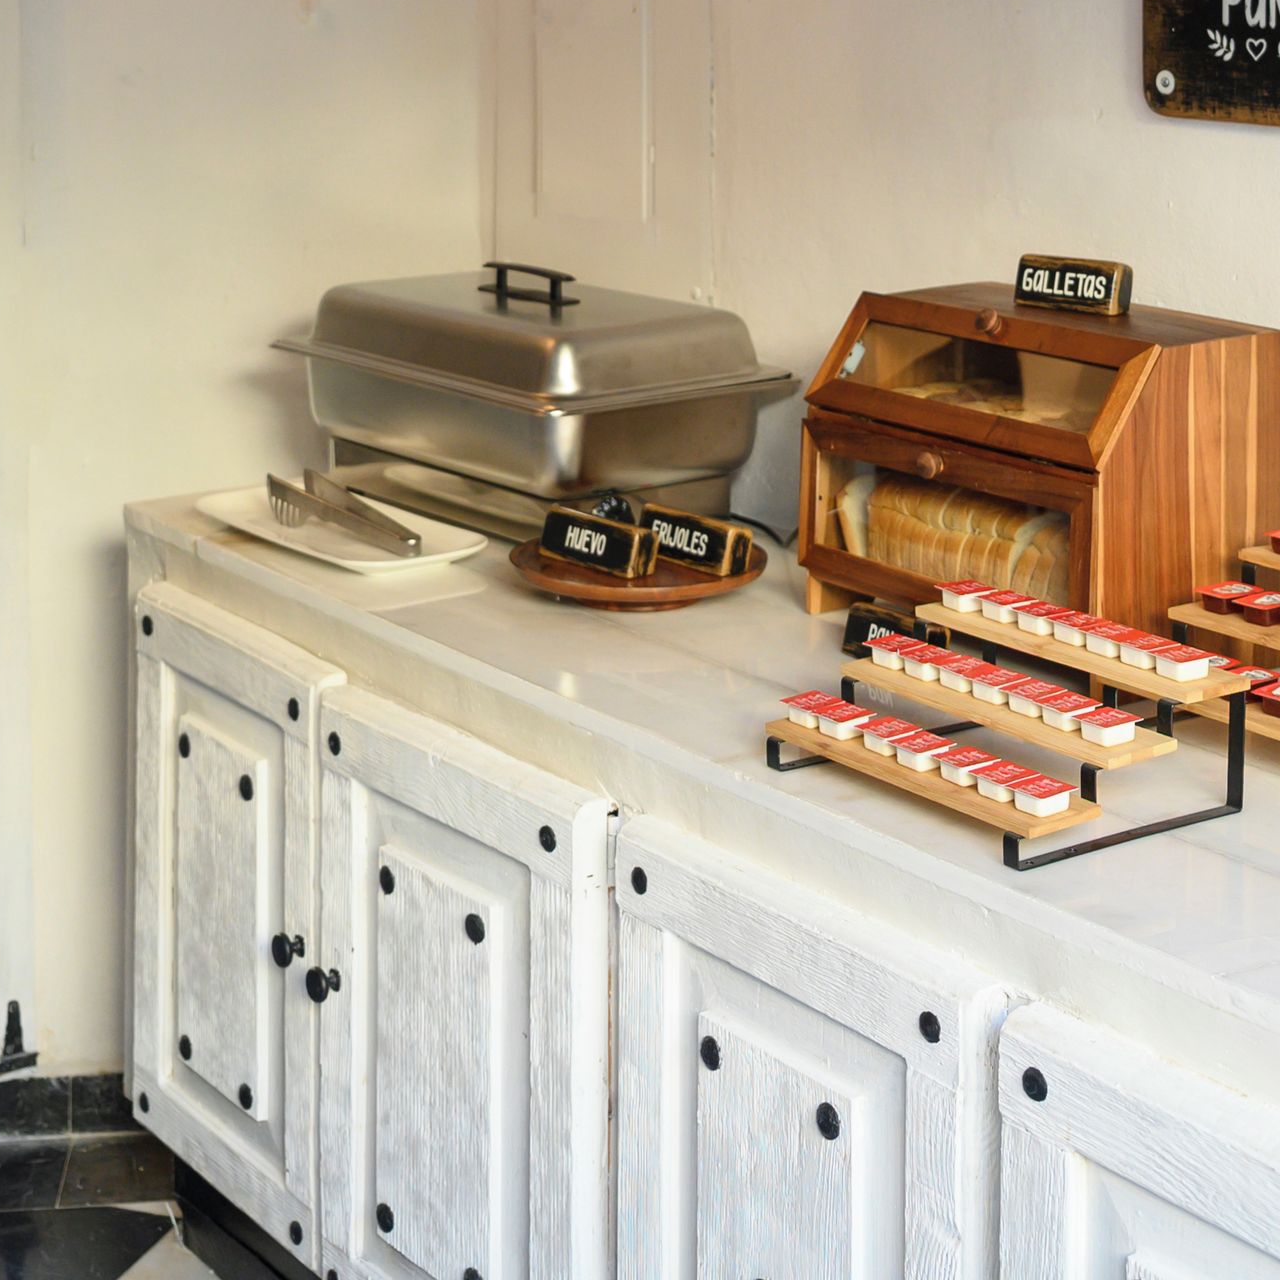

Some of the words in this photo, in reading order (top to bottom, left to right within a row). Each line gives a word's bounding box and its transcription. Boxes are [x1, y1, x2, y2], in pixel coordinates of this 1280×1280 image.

[1022, 268, 1107, 299] GALLETAS
[564, 525, 607, 556] HUEVO
[652, 519, 709, 557] FRIJOLES
